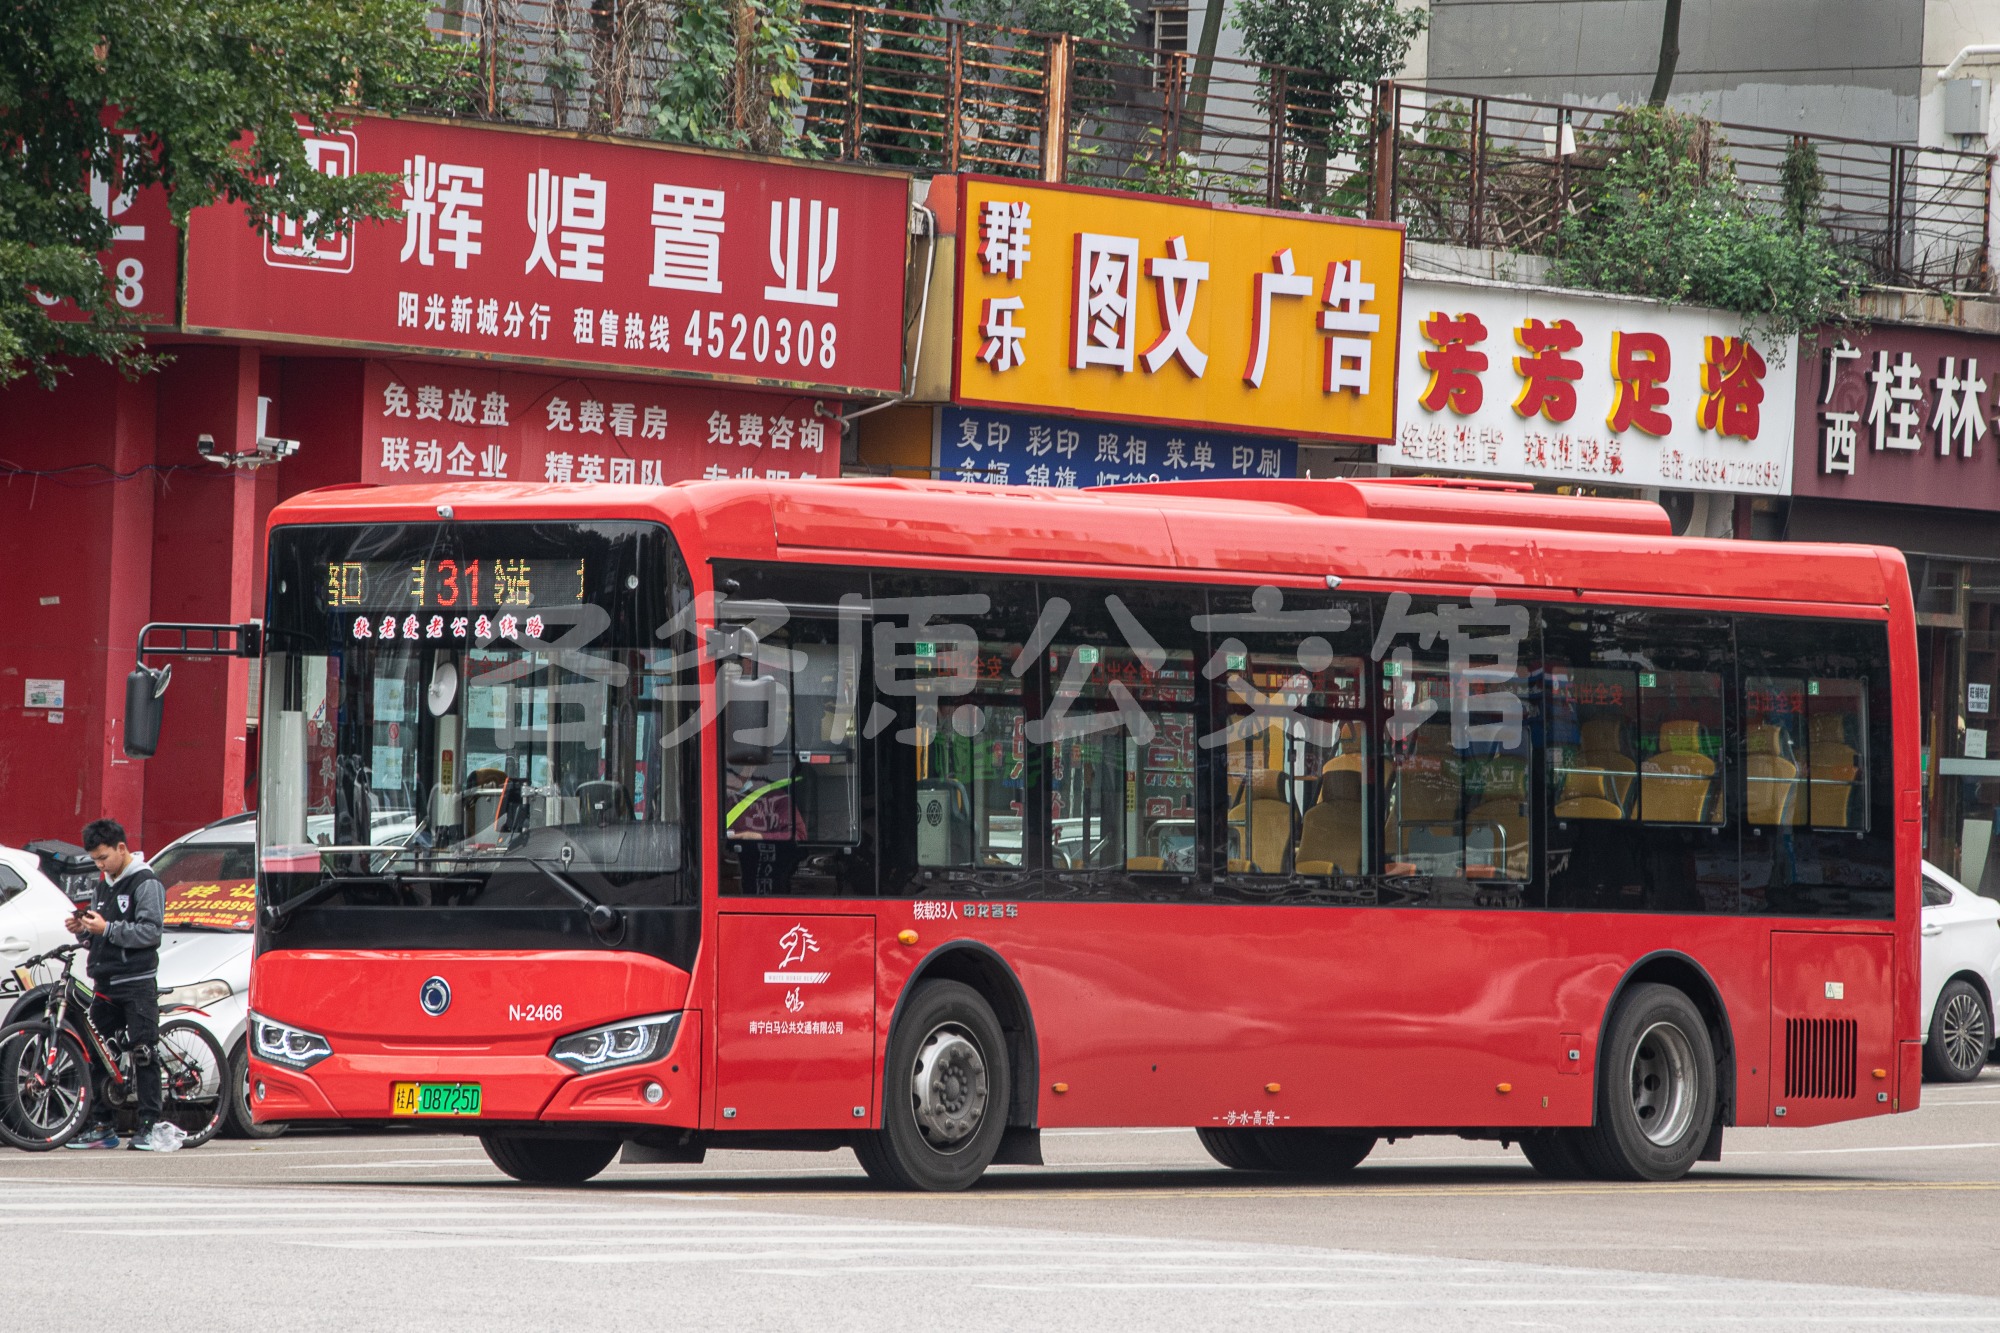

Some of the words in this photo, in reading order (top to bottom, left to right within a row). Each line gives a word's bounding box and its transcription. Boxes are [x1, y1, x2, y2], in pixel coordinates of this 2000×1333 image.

[401, 155, 839, 307] 辉煌置业
[977, 200, 1031, 373] 群乐
[398, 291, 551, 341] 阳光新城分行
[573, 307, 670, 354] 租售热线
[684, 310, 837, 369] 4520308
[1418, 311, 1766, 442] 芳芳足浴
[1868, 350, 2000, 458] 桂林
[383, 381, 509, 427] 免费放盘
[546, 396, 667, 440] 免费看房
[706, 409, 824, 453] 免费咨询
[1825, 338, 1862, 475] 广西
[381, 437, 507, 479] 联动企业
[545, 451, 664, 486] 精英团队
[957, 417, 1010, 453] 复印
[1025, 425, 1080, 460] 彩印
[1094, 433, 1147, 466] 照相
[1163, 438, 1215, 471] 菜单
[1231, 445, 1281, 478] 印刷
[437, 559, 479, 606] 31
[353, 614, 544, 640] 敬老爱老公交线路
[165, 900, 255, 912] 3377189990
[913, 901, 958, 920] 核载83人
[963, 904, 1018, 918] 申龙客车
[509, 1004, 563, 1021] N-2466
[749, 1021, 844, 1035] 南宁白马公共交通有限公司
